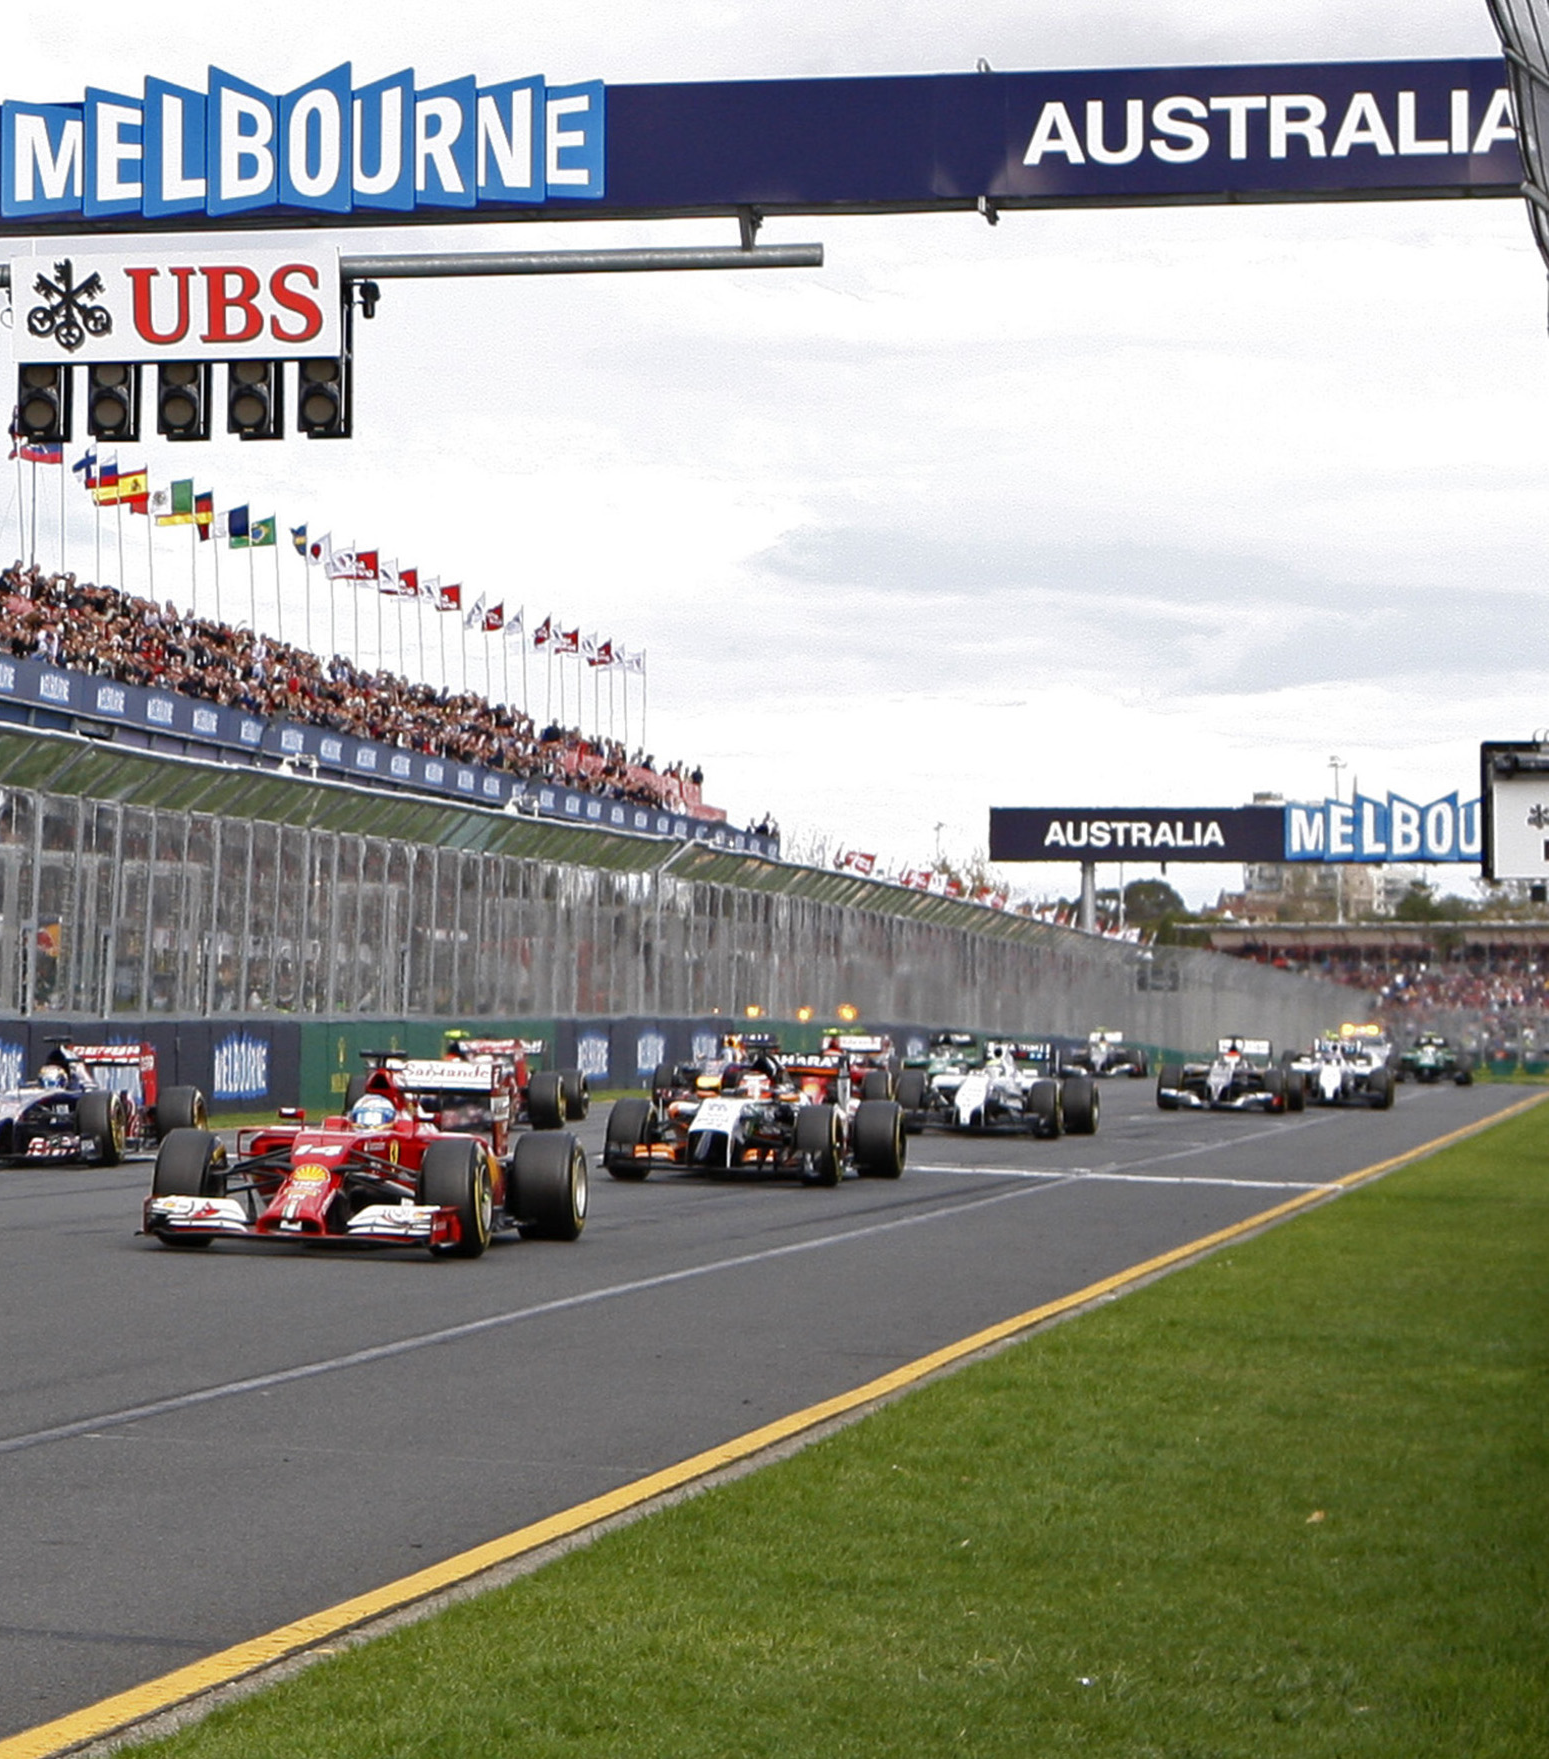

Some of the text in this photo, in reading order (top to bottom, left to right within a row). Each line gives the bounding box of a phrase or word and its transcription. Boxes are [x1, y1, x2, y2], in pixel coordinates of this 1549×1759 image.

[13, 87, 591, 202] MELBOURNE
[1023, 89, 1522, 166] AUSTRALIA
[126, 264, 323, 343] UBS
[1045, 822, 1225, 847] AUSTRALIA
[294, 1144, 343, 1156] 14
